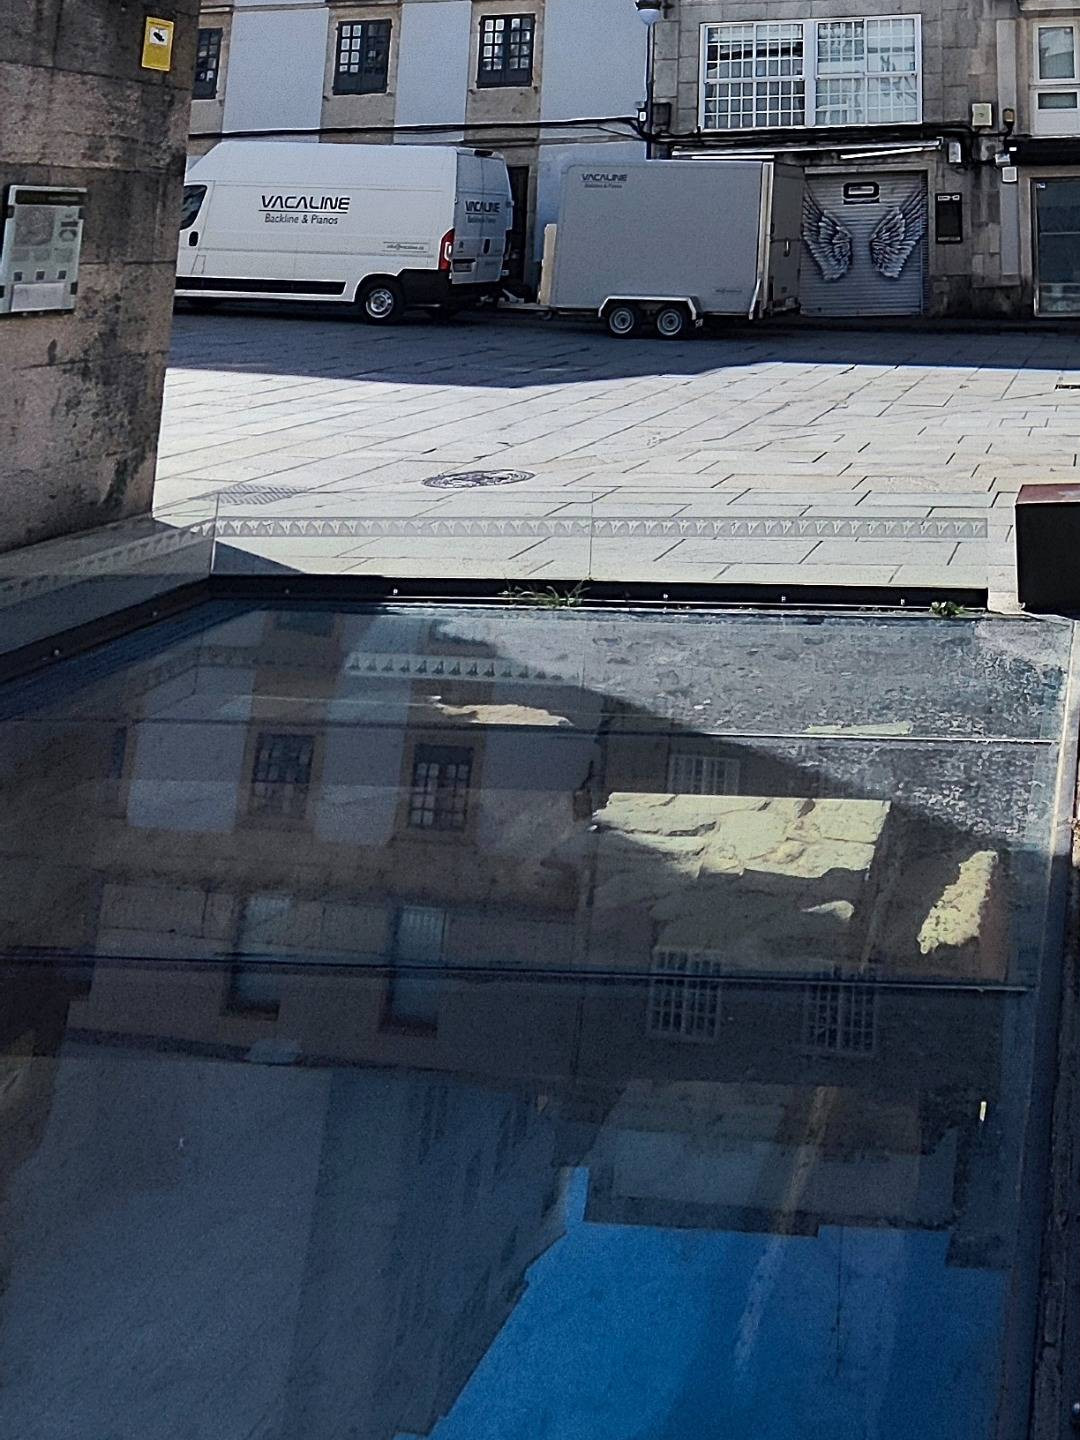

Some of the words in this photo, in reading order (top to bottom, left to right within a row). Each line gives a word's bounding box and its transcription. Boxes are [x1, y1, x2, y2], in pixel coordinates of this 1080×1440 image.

[261, 195, 351, 211] VACALINE
[264, 212, 300, 224] Backline
[301, 214, 308, 224] &
[310, 214, 339, 225] Pianos
